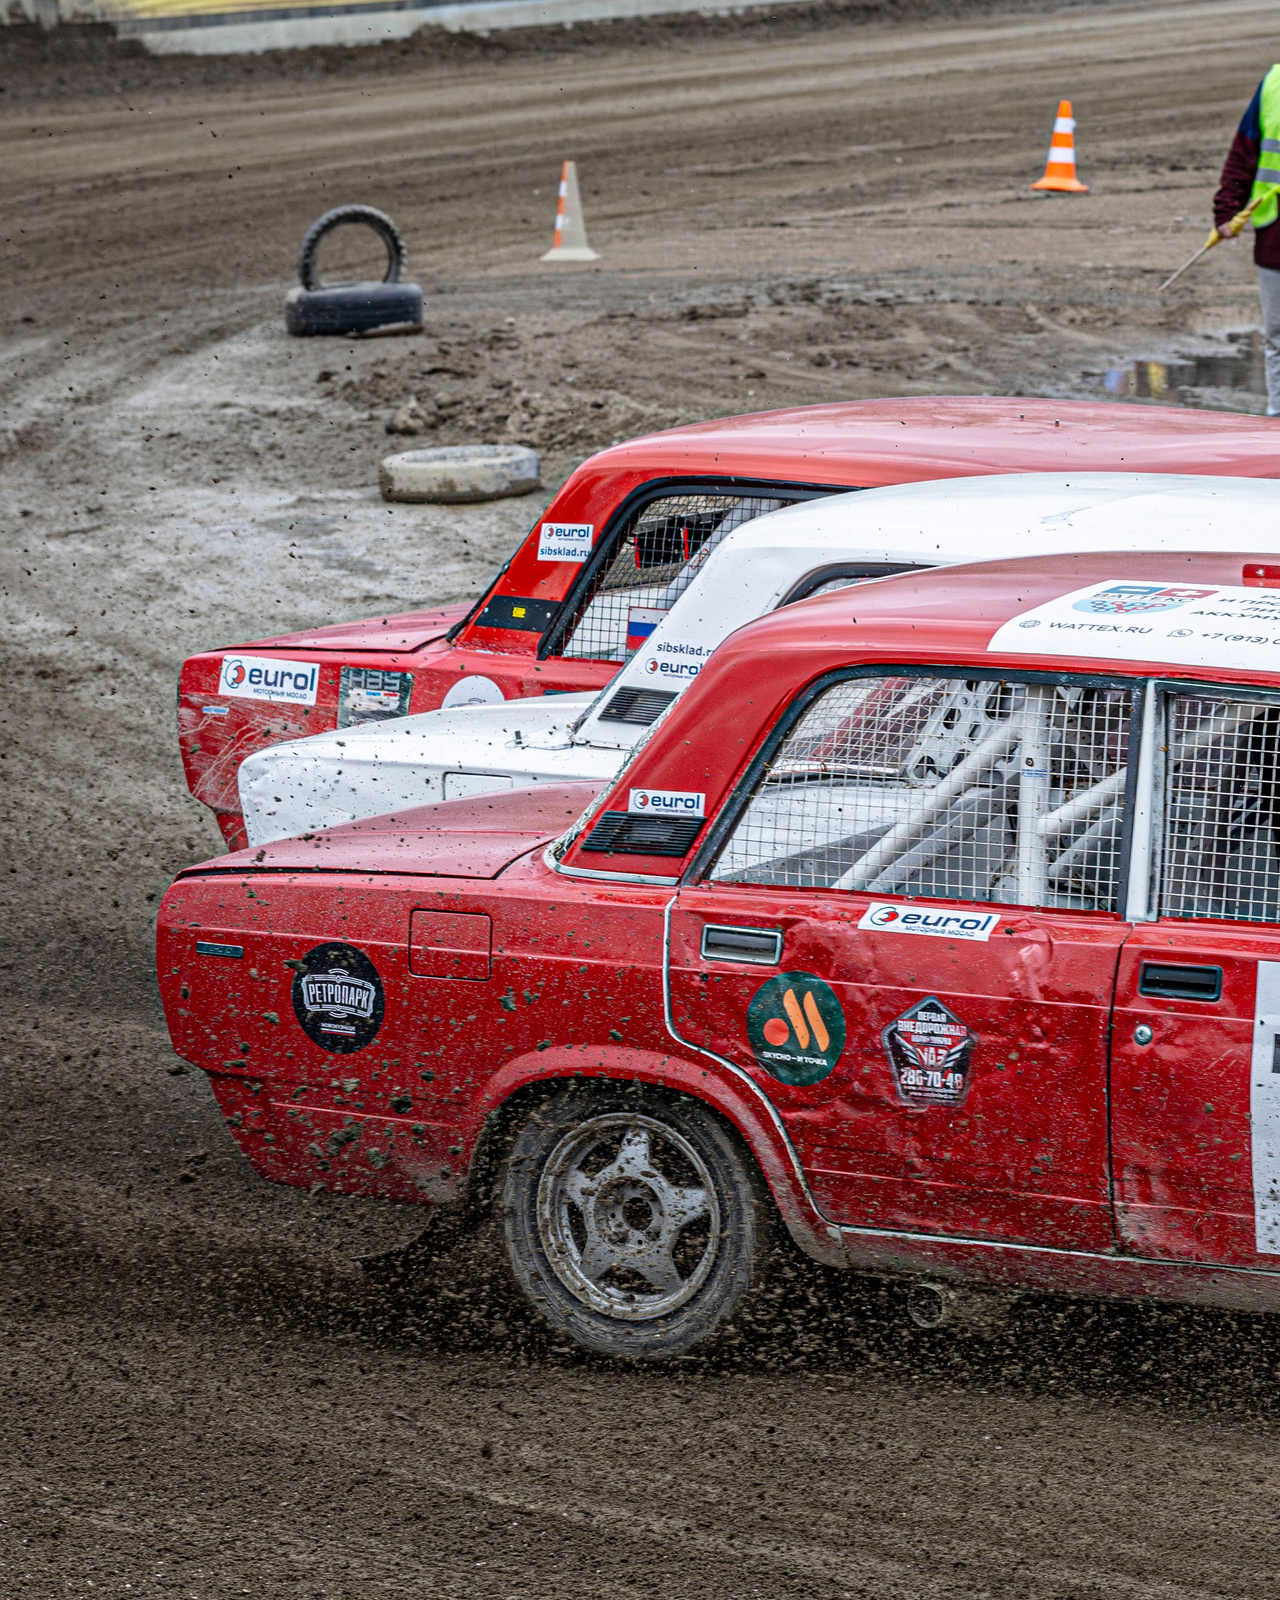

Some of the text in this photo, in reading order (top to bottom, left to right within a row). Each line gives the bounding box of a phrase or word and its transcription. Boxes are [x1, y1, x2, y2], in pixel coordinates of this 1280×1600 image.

[555, 526, 589, 538] eurol
[540, 548, 589, 558] sibsklad.ru
[1049, 622, 1154, 634] WATTEX.RU
[1224, 634, 1269, 645] (913)
[657, 642, 715, 657] sibsklad.r
[248, 667, 316, 692] eurol
[651, 795, 700, 809] eurol
[901, 913, 993, 931] eurol
[308, 983, 370, 1010] РЕТРОПАРК
